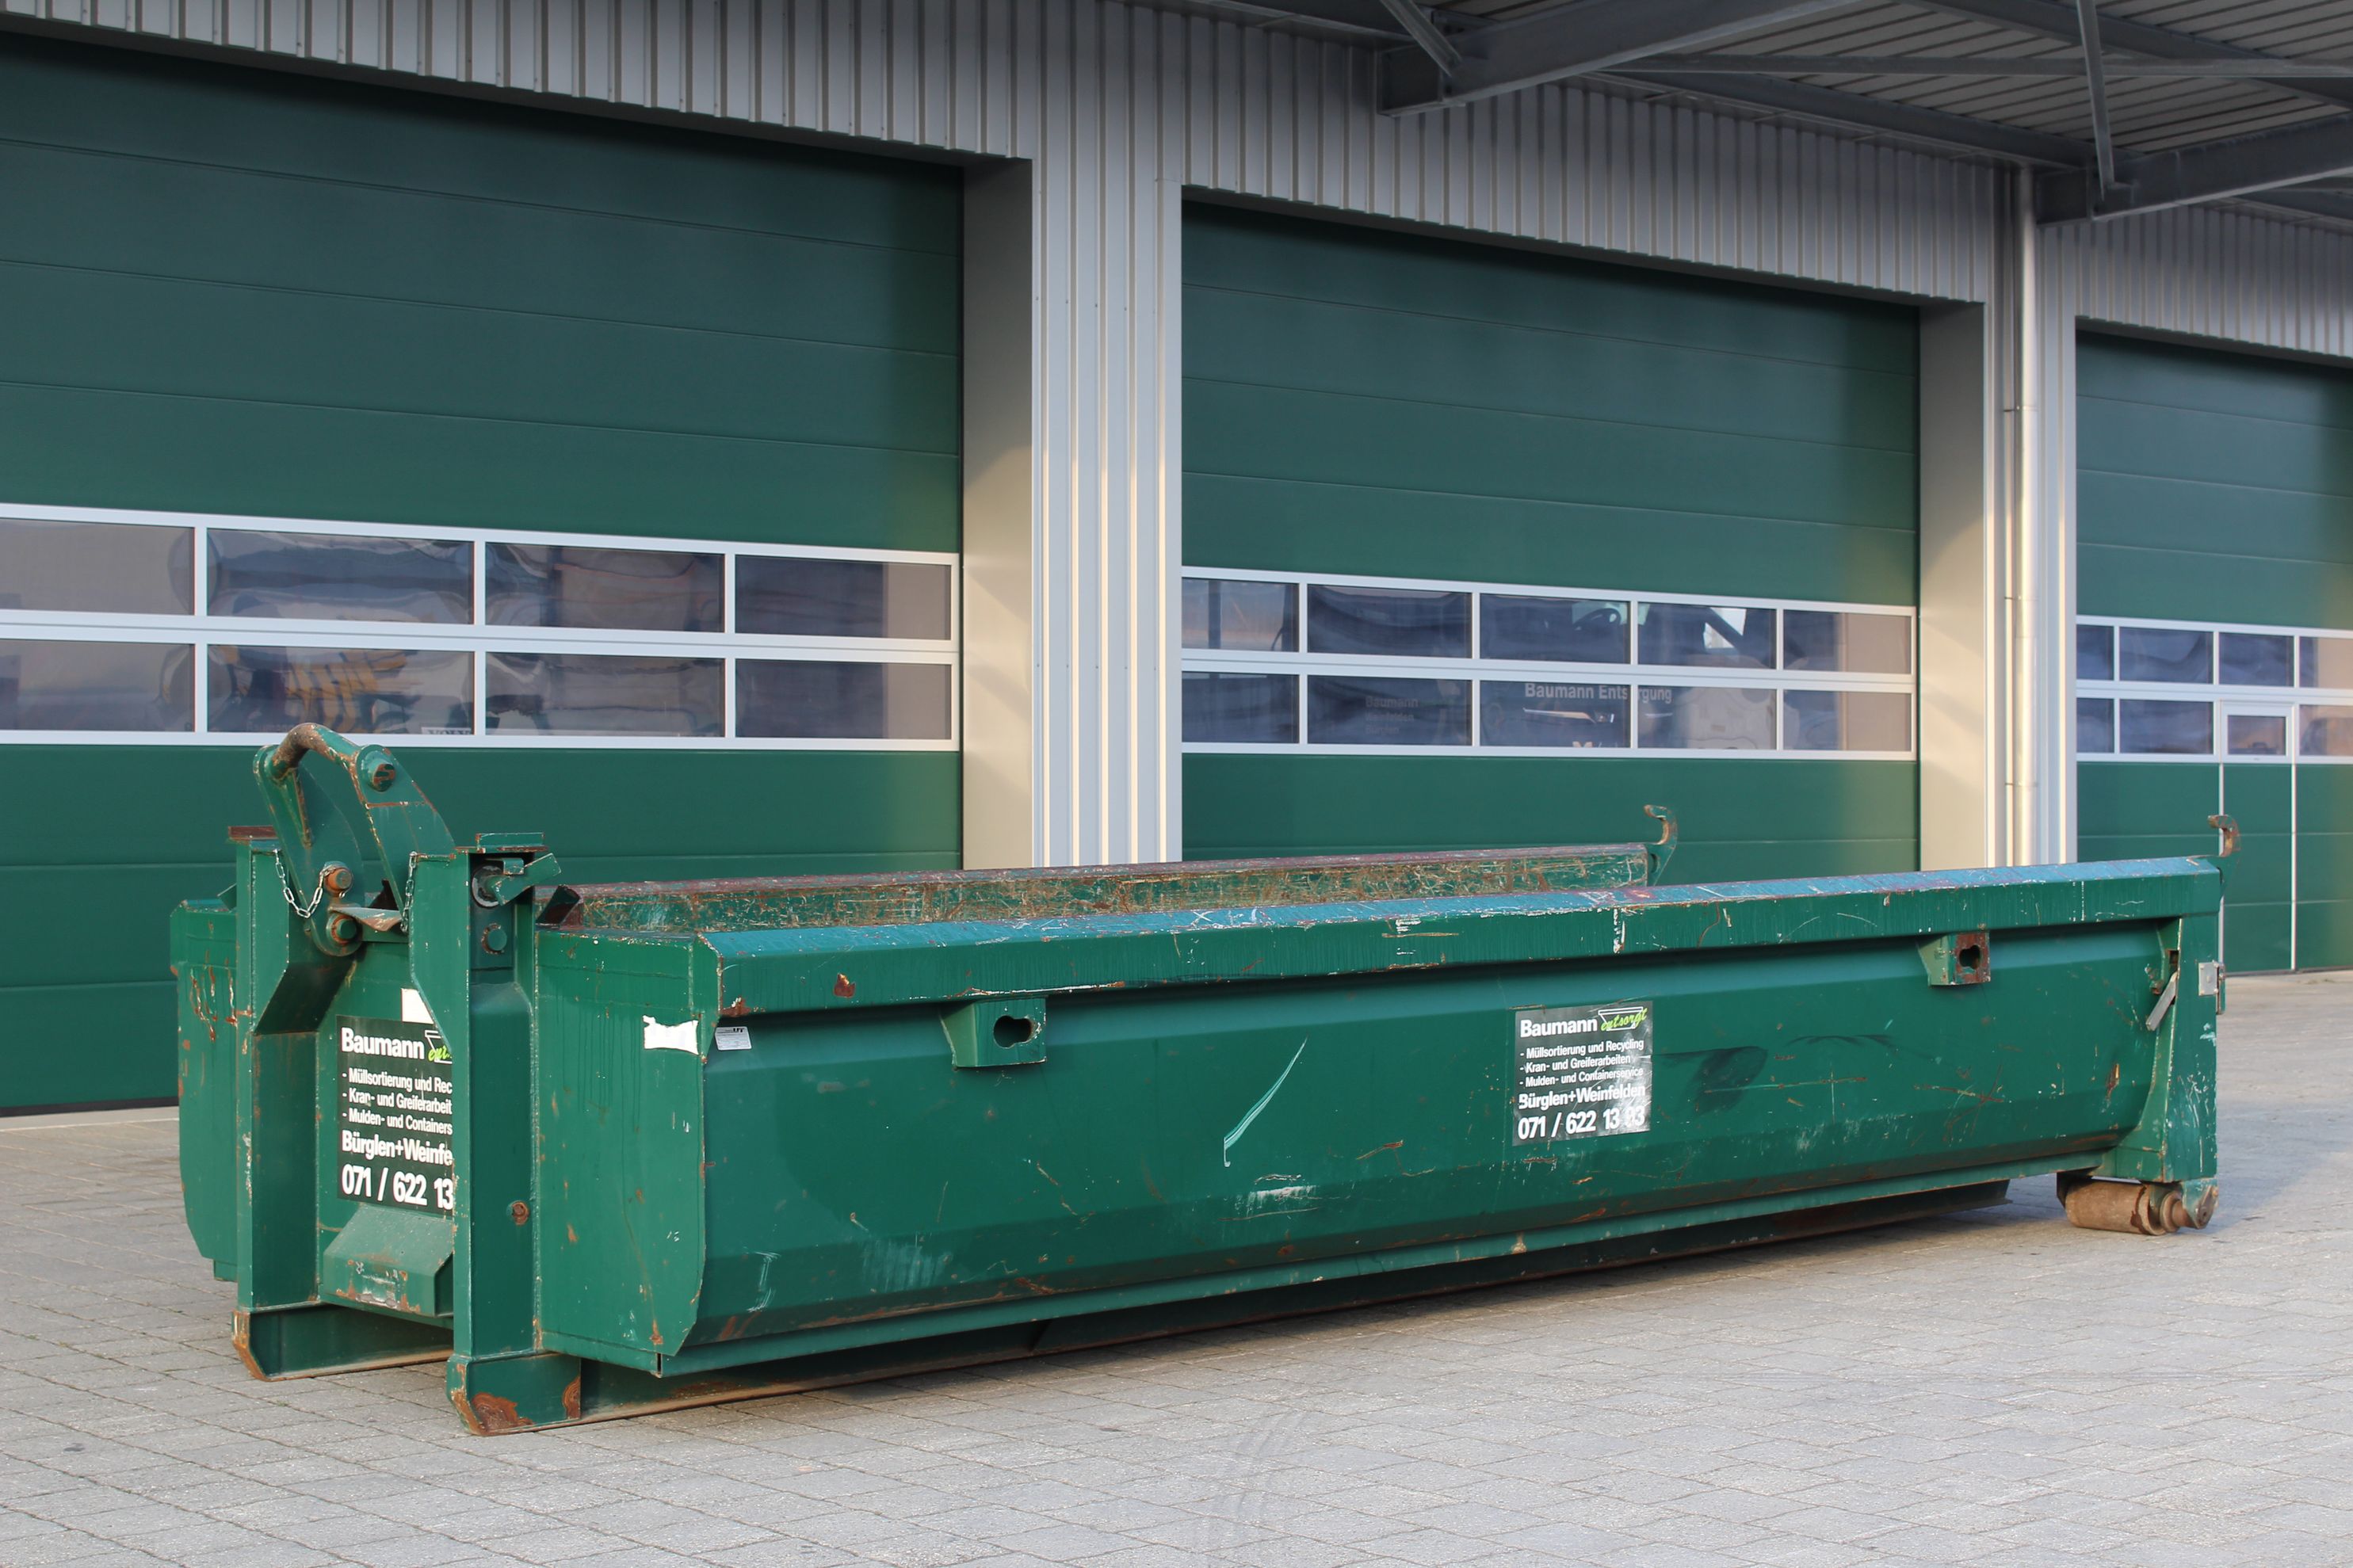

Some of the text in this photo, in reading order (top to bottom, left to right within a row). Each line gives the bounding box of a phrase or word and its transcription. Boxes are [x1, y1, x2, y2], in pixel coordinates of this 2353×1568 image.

[1365, 696, 1419, 708] Baumann
[1525, 683, 1672, 704] Baumann Entsrgung
[1520, 1018, 1598, 1037] Baumann
[341, 1027, 425, 1059] Baumann
[1526, 1045, 1585, 1059] Müllsortierung
[1588, 1042, 1604, 1052] und
[1606, 1039, 1644, 1051] Recycling
[1526, 1062, 1550, 1074] Kran-
[1553, 1059, 1568, 1070] und
[1571, 1054, 1631, 1069] Greiferarbeiten
[1526, 1076, 1559, 1088] Mulden-
[1561, 1073, 1577, 1083] und
[1579, 1066, 1644, 1082] Containerservice
[349, 1067, 413, 1093] Müllsortierung
[414, 1078, 433, 1091] und
[434, 1080, 453, 1094] Rec
[349, 1087, 375, 1104] Kran-
[376, 1092, 395, 1107] und
[396, 1093, 453, 1114] Greiferarbeit
[1518, 1083, 1646, 1111] Bürglen+Weinfelden
[349, 1108, 385, 1125] Mulden-
[387, 1114, 404, 1128] und
[405, 1115, 453, 1135] Containers
[1518, 1116, 1546, 1140] 071
[1551, 1112, 1562, 1138] /
[1565, 1110, 1596, 1135] 622
[1602, 1108, 1620, 1130] 13
[342, 1163, 453, 1210] 071 / 622 13
